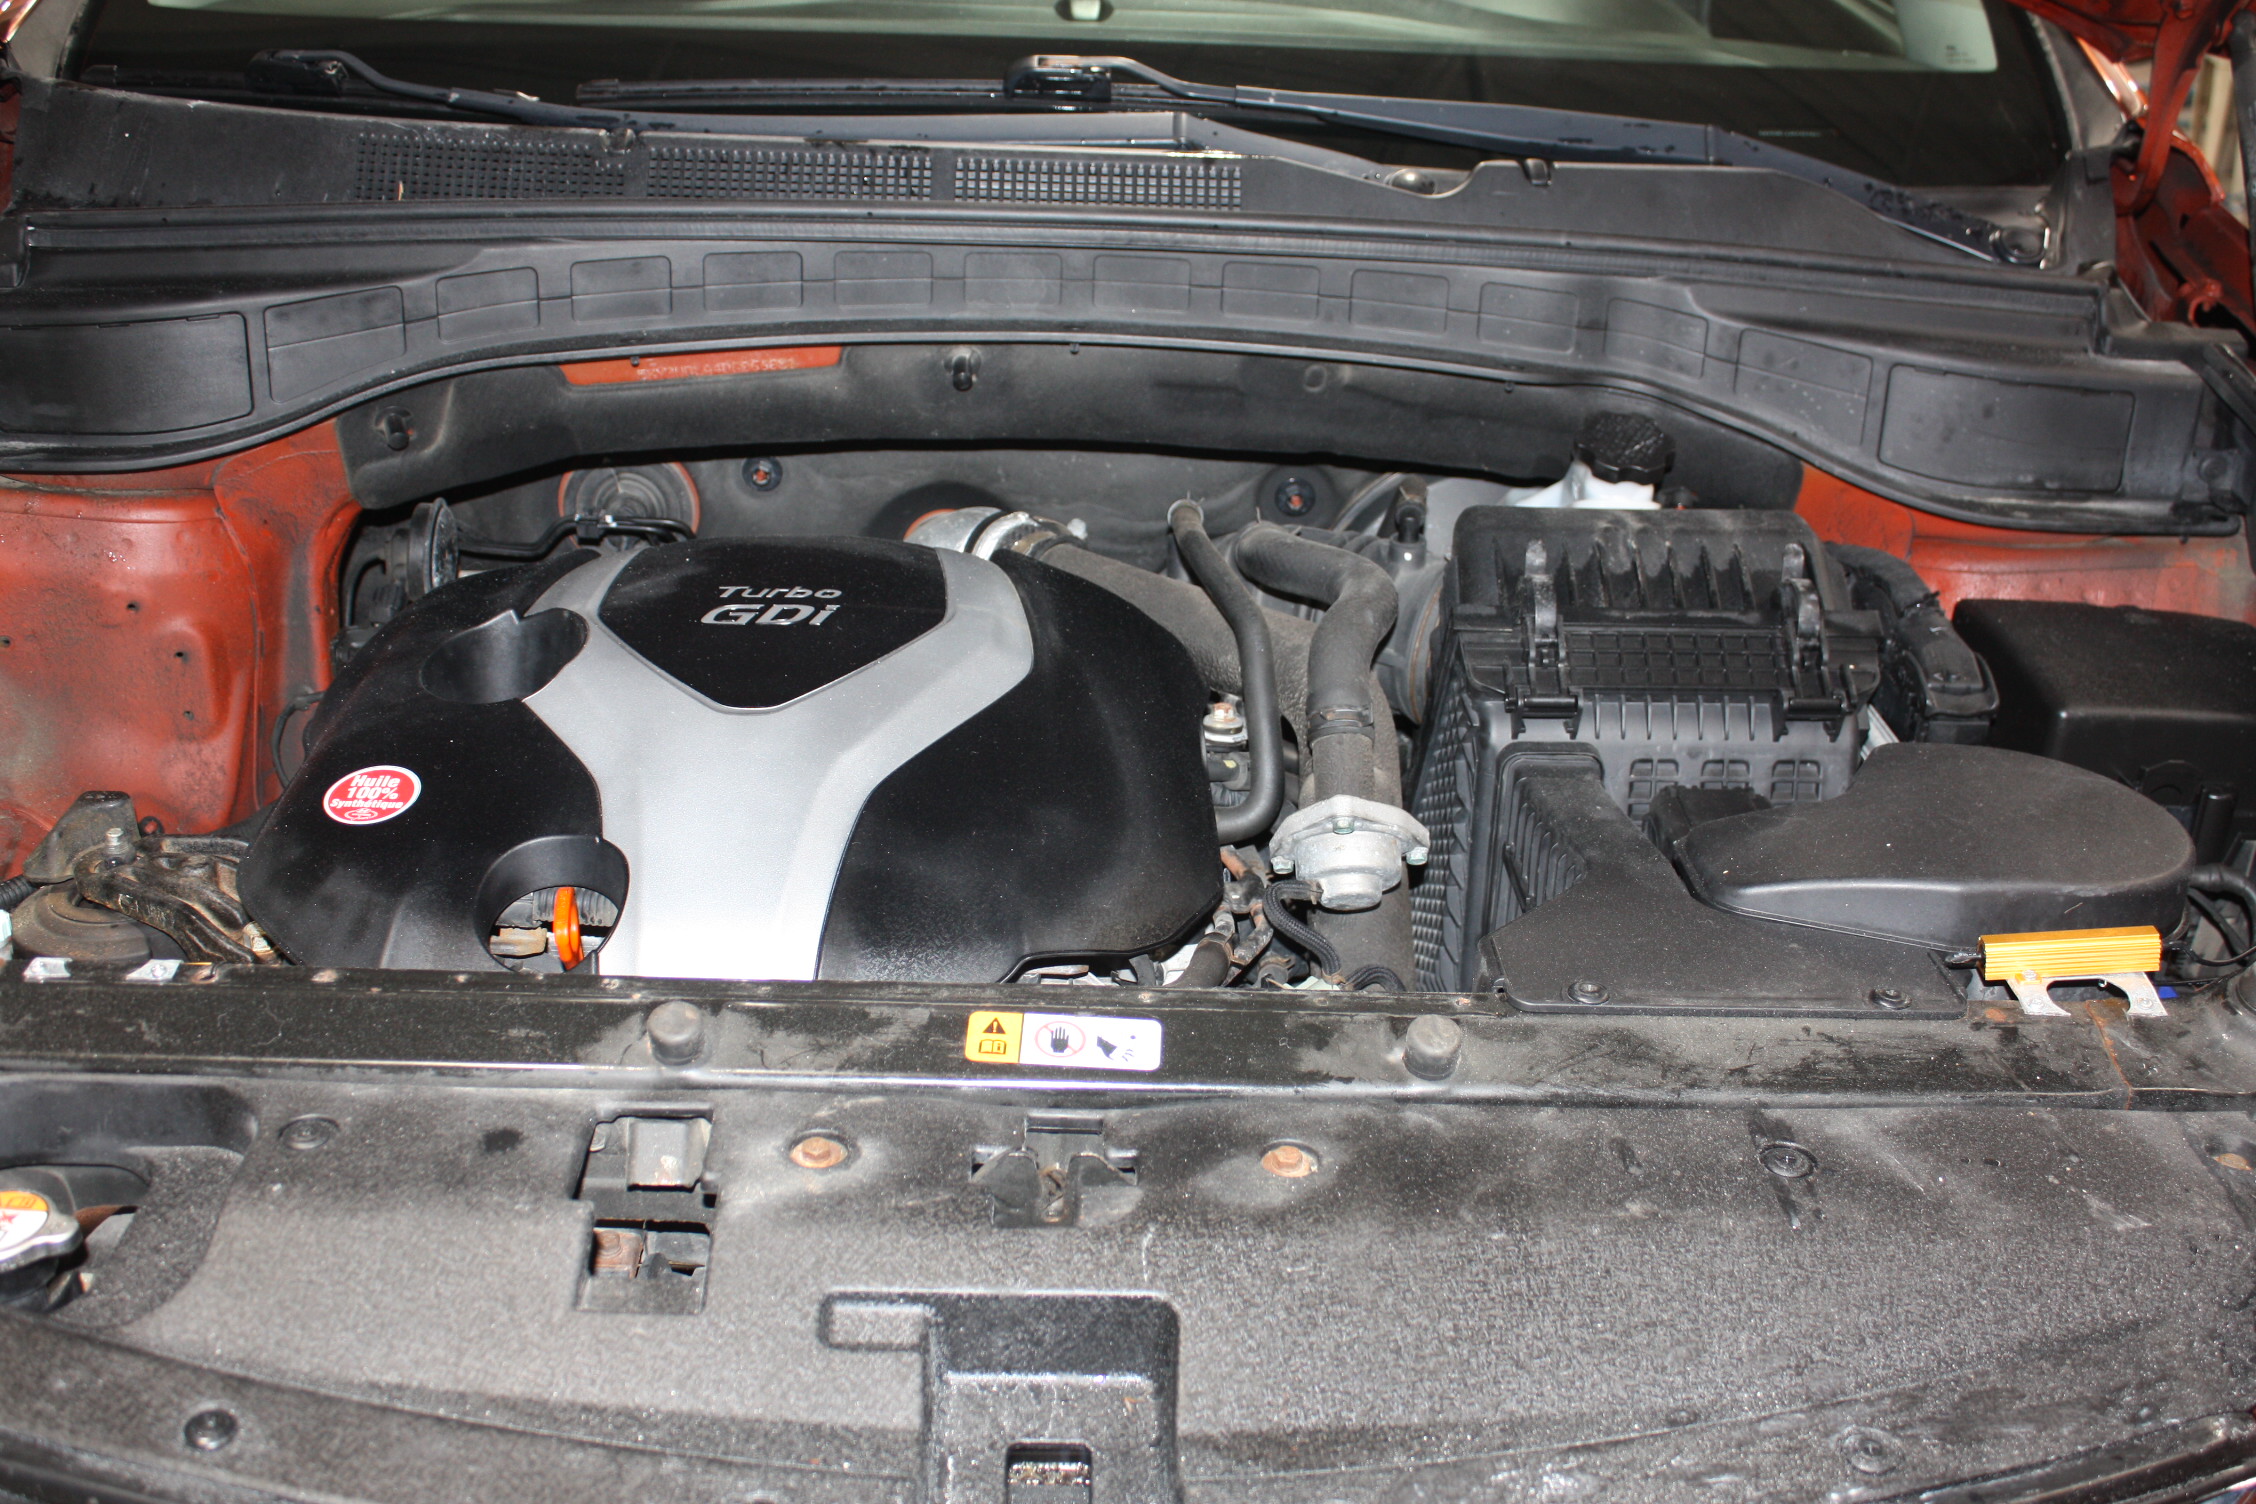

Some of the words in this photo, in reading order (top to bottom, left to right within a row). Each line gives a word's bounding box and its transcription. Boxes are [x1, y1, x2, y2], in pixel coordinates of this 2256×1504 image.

[718, 586, 842, 598] Turbo
[701, 604, 841, 626] GDi
[350, 774, 401, 788] Huile
[347, 786, 399, 800] 100%
[330, 798, 404, 809] Synthétique
